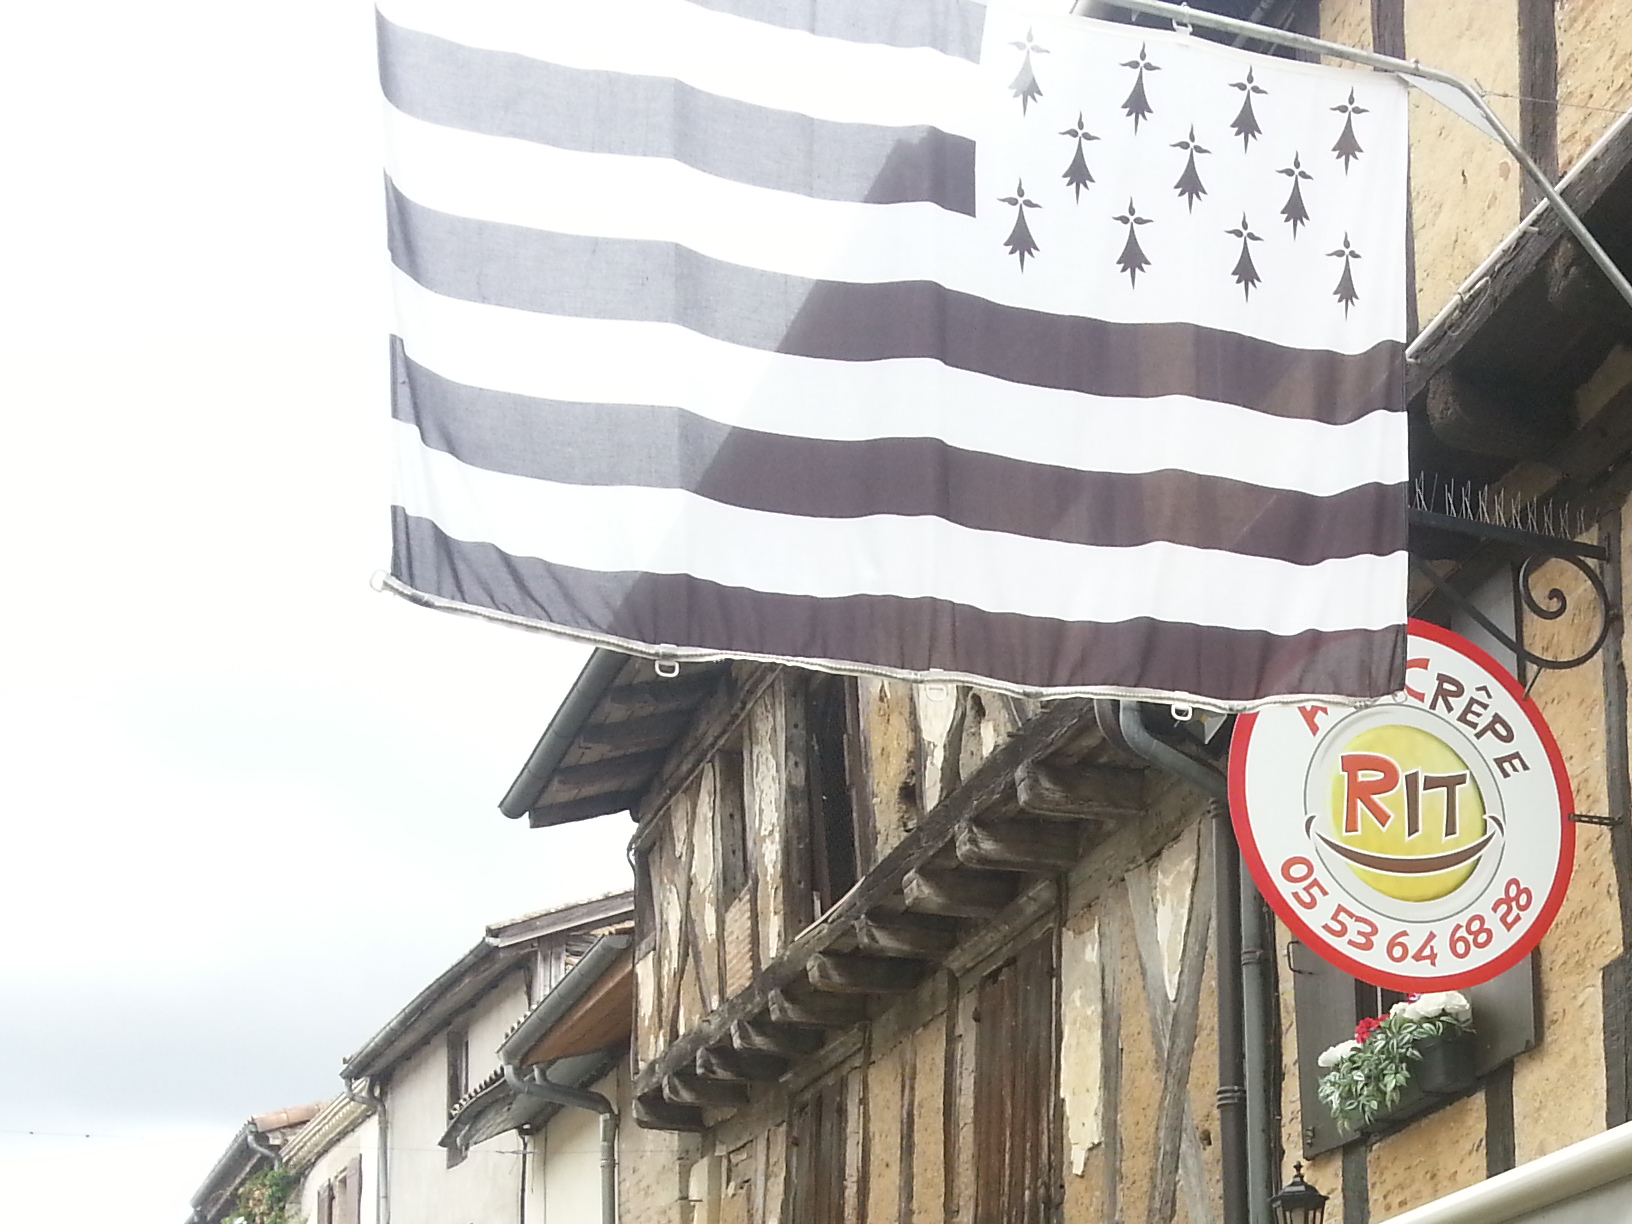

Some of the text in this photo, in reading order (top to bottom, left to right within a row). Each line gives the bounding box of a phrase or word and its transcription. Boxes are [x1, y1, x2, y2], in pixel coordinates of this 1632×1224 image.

[1339, 753, 1469, 840] RIT
[1280, 855, 1533, 967] 05 53 64 68 28
